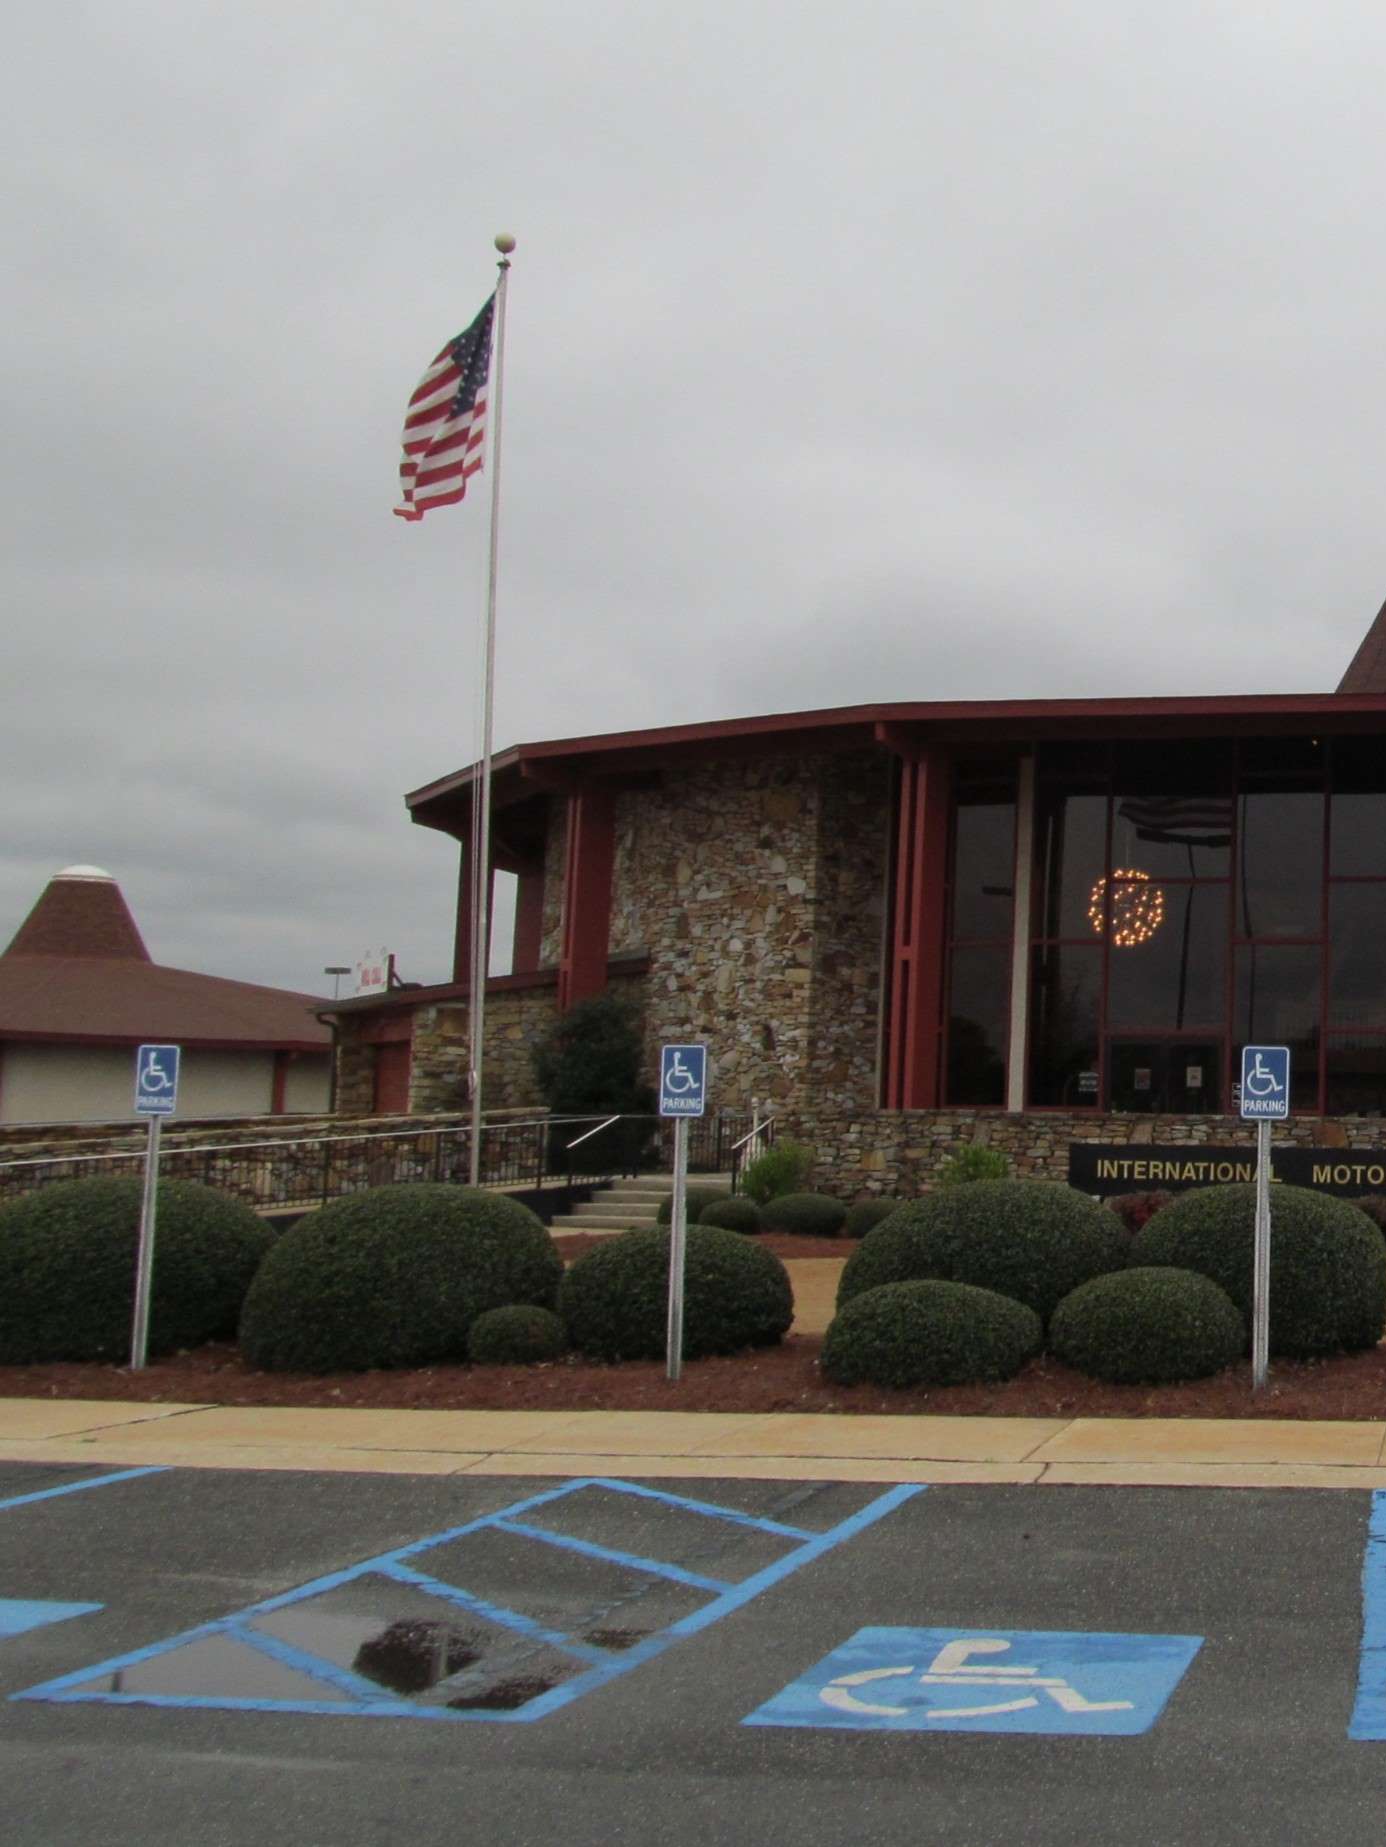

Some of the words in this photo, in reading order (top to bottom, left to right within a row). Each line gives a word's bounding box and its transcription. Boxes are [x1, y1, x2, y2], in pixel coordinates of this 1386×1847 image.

[138, 1096, 174, 1109] PARKING
[662, 1097, 702, 1111] PARKING
[1243, 1099, 1285, 1114] PARKING
